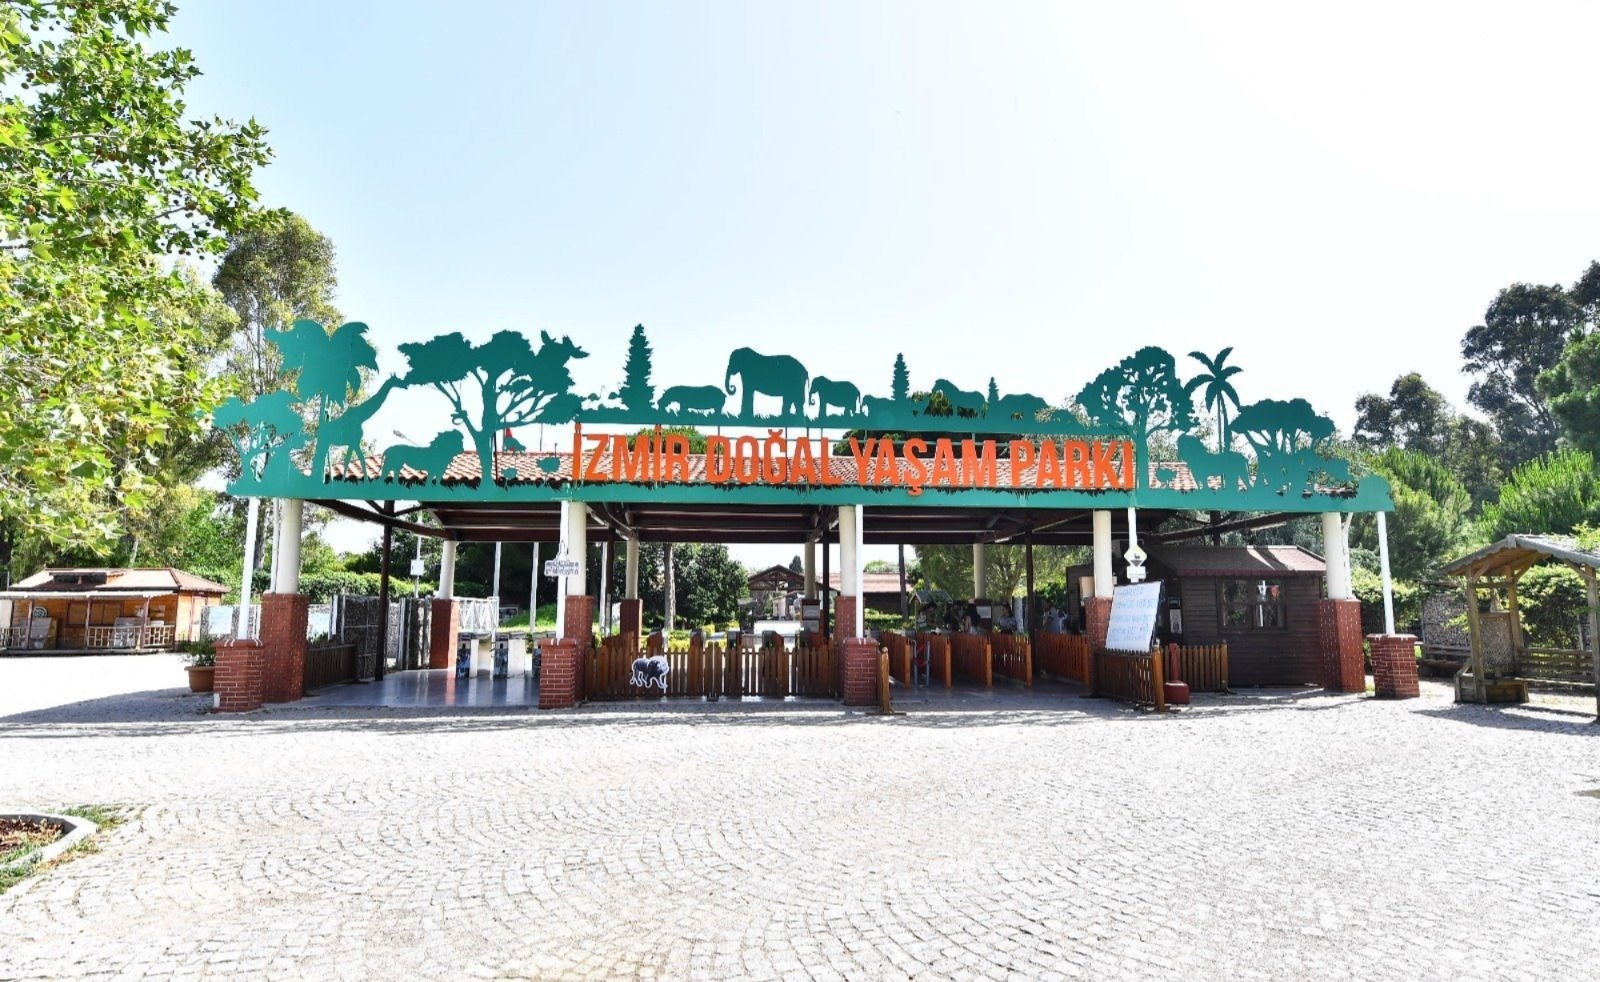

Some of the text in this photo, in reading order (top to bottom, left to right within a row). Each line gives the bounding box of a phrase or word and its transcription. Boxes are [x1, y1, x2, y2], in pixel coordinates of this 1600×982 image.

[572, 422, 1134, 496] İZMİR DOĞAL YAŞAM PARKI
